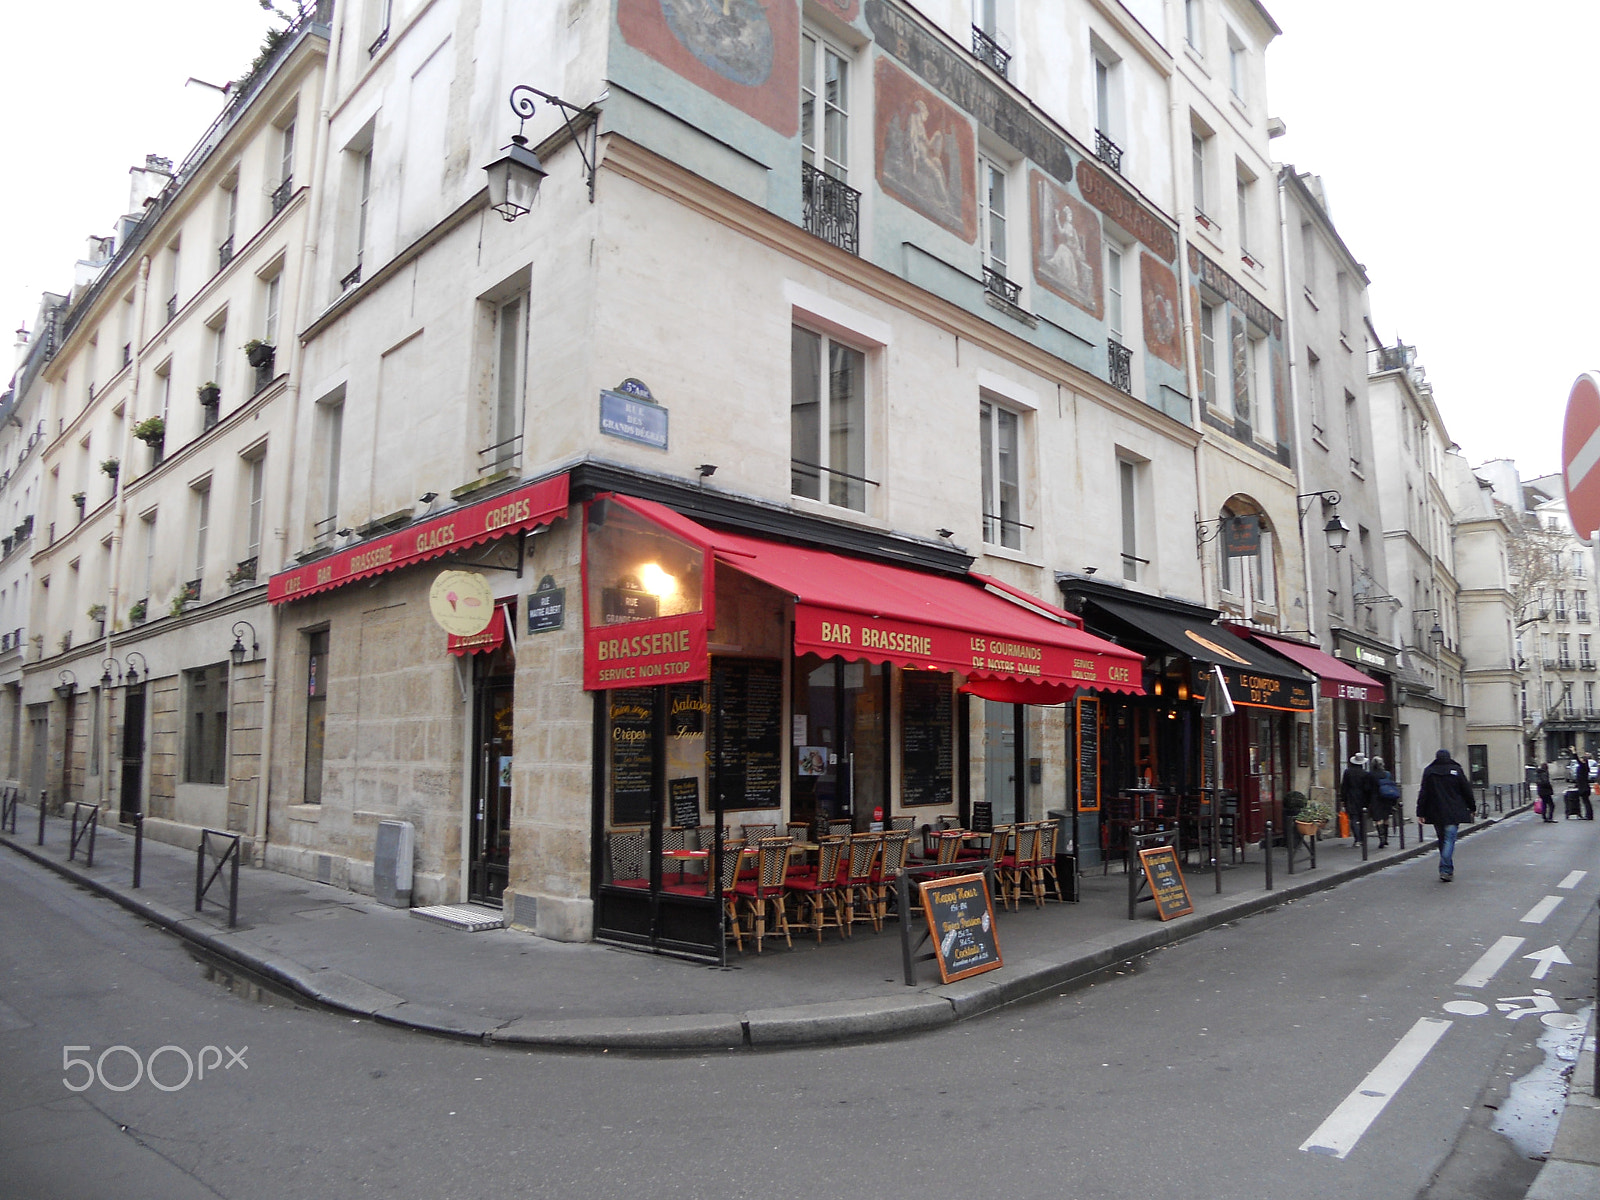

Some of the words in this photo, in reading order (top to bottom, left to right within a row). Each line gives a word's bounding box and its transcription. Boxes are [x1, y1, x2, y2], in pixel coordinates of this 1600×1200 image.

[626, 404, 644, 416] RUE
[602, 419, 634, 434] GRANDS
[627, 415, 643, 426] DES
[285, 576, 301, 594] CAFE
[317, 566, 332, 584] BAR
[351, 544, 393, 574] BRASSERIE
[416, 524, 455, 552] GLACES
[485, 498, 530, 531] CREPES
[625, 597, 639, 607] RUE
[598, 630, 690, 661] BRASSERIE
[821, 622, 851, 644] BAR
[862, 627, 932, 655] BRASSERIE
[970, 637, 986, 652] LES
[990, 641, 1042, 660] GOURMANDS
[599, 666, 636, 681] SERVICE
[639, 664, 662, 677] NON
[664, 661, 690, 675] STOP
[972, 656, 985, 670] DE
[987, 658, 1016, 673] NOTRE
[1017, 662, 1041, 677] DAME
[1108, 666, 1129, 682] CAFE
[1240, 674, 1249, 688] LE
[671, 694, 712, 716] Salades
[613, 727, 646, 745] Crêpes
